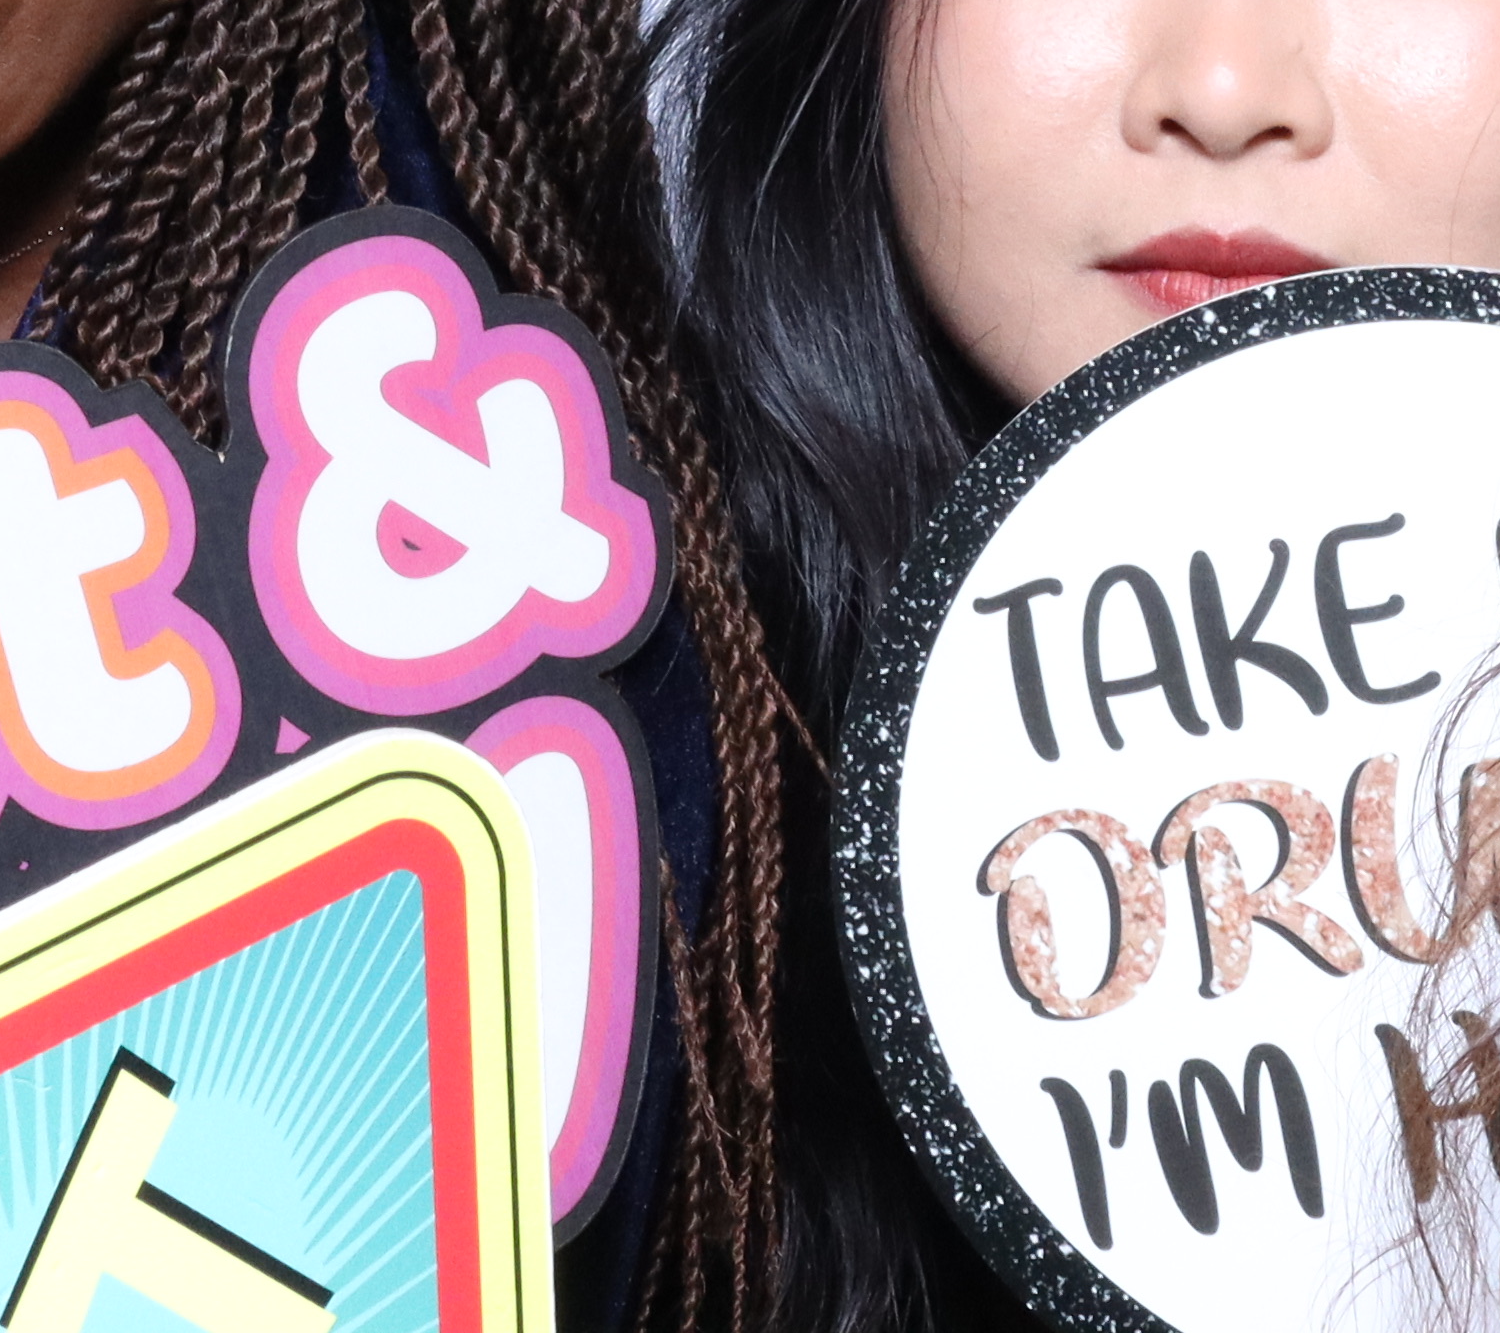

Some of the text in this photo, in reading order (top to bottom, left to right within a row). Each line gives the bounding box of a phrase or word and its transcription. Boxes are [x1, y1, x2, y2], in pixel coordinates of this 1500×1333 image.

[293, 288, 612, 662] &
[970, 510, 1442, 763] TAKE
[1038, 1040, 1325, 1251] I'M
